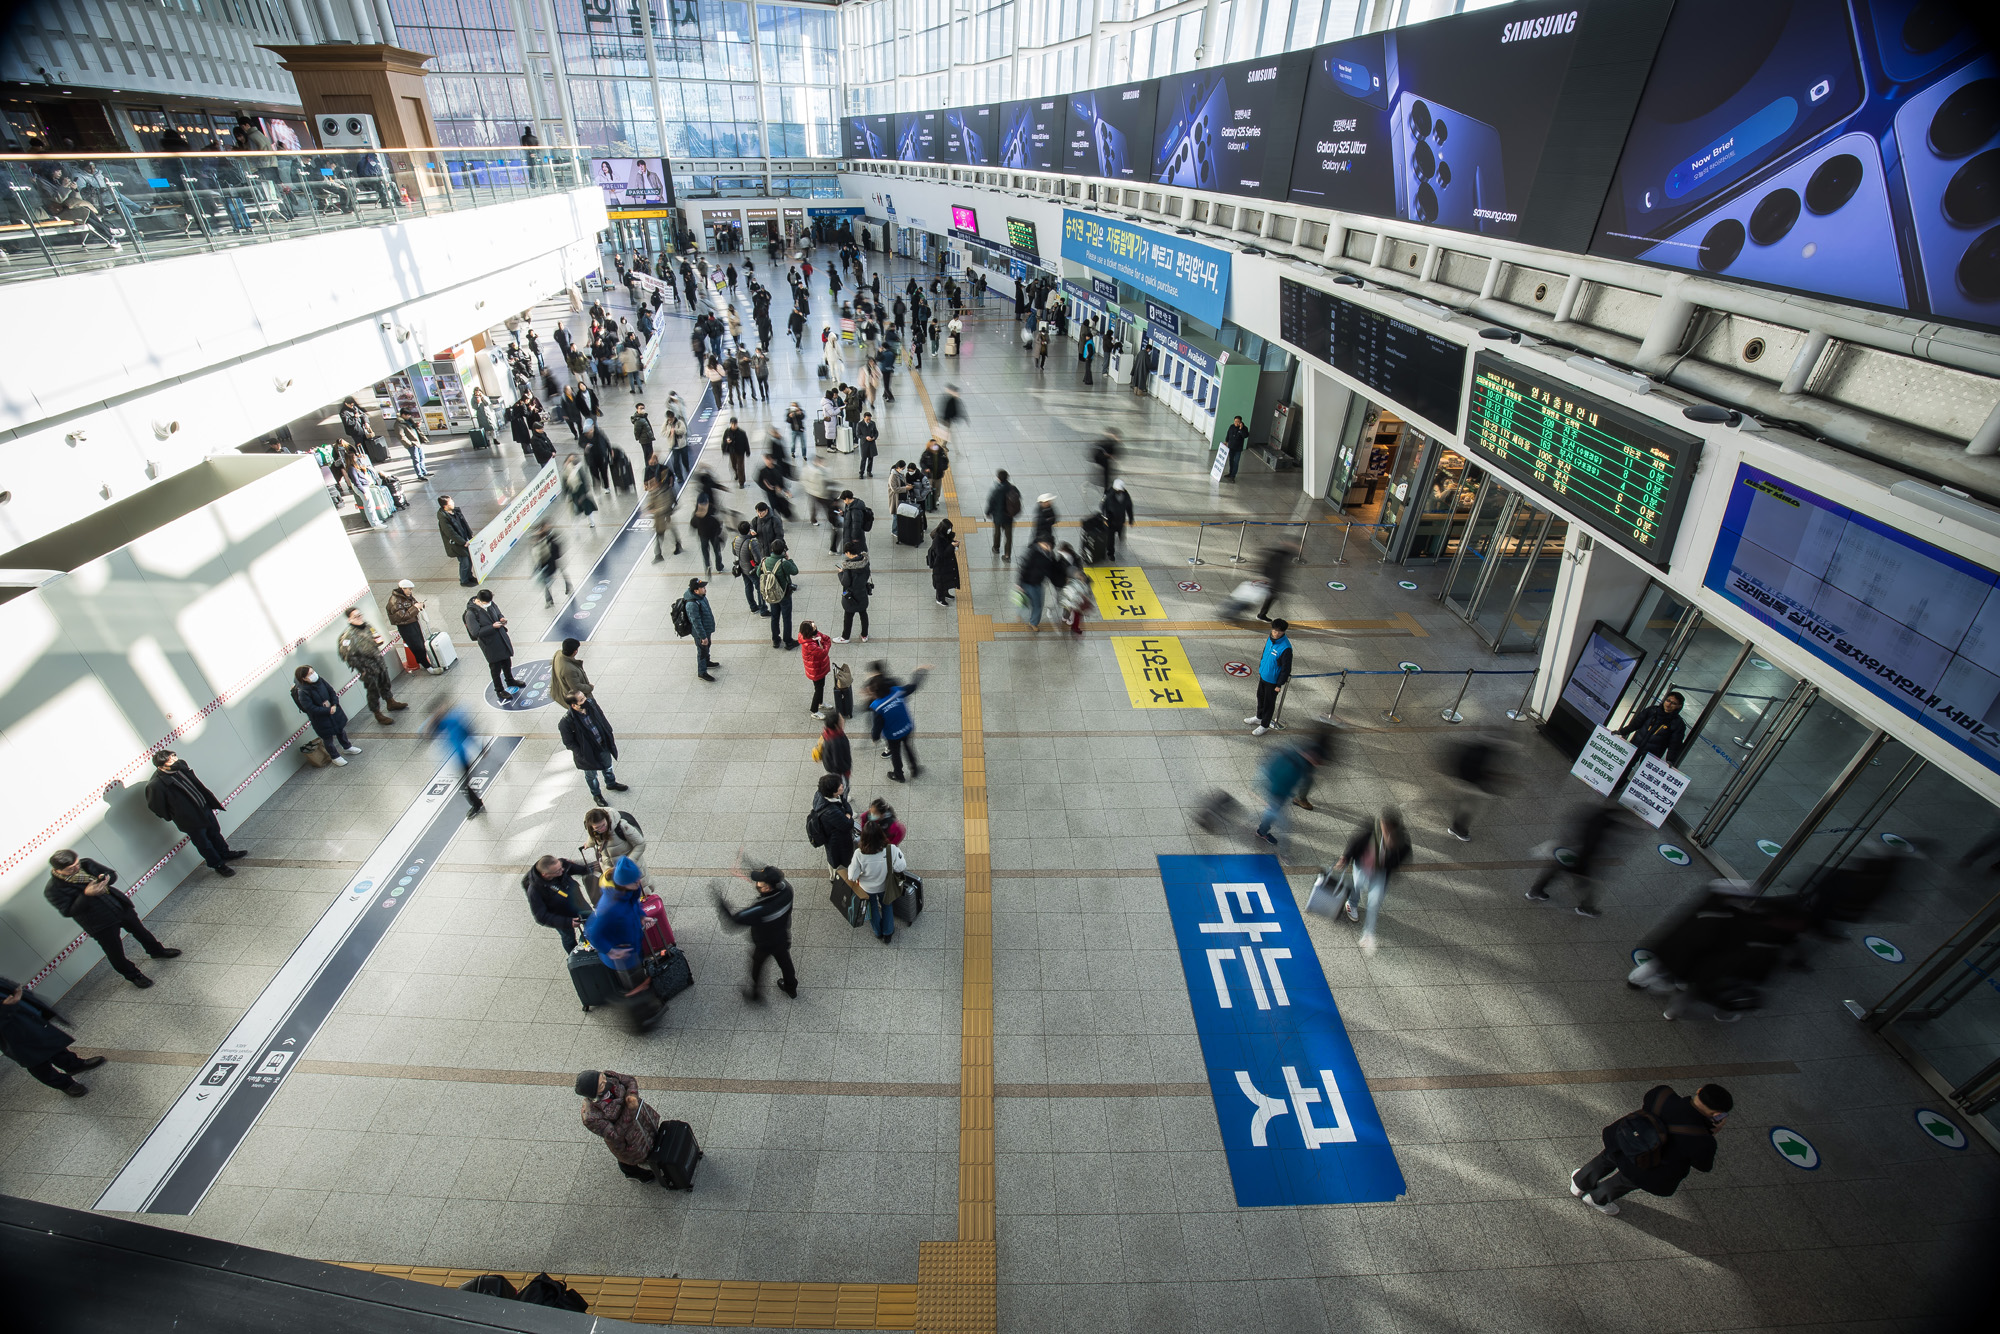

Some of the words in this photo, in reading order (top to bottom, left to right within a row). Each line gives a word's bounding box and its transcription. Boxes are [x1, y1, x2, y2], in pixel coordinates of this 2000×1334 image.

[1501, 10, 1578, 44] SAMSUNG
[1247, 67, 1277, 83] SAMSUNG
[1221, 127, 1237, 139] Galaxy
[1245, 125, 1261, 137] Series
[1316, 141, 1338, 156] Galaxy
[1338, 141, 1350, 154] S25
[1350, 141, 1367, 155] Ultra
[1691, 153, 1711, 171] Now
[1712, 137, 1735, 158] Brief
[1322, 160, 1340, 173] Galaxy
[1693, 166, 1709, 180] 오늘의
[1473, 207, 1517, 222] samsung.com
[1066, 216, 1084, 242] 승차권
[1086, 221, 1104, 248] 구입은
[1106, 226, 1150, 264] 자동발매기가
[1151, 244, 1173, 270] 빠르고
[1176, 251, 1219, 294] 편리합니다.
[1086, 250, 1097, 263] Please
[1106, 257, 1117, 270] ticket
[1117, 262, 1134, 276] machine
[1145, 274, 1157, 290] quick
[1157, 280, 1179, 297] purchase.
[1389, 319, 1418, 336] DEPARTURES
[1153, 328, 1167, 346] Foreign
[1167, 336, 1178, 350] Cards
[1178, 342, 1188, 355] NOT
[1187, 348, 1207, 369] Available
[1485, 399, 1500, 413] 10:12
[1502, 408, 1514, 419] KTX
[1542, 427, 1553, 439] 123
[1561, 437, 1575, 452] 부산
[1622, 470, 1629, 479] 8
[1487, 390, 1502, 402] 10:07
[1504, 398, 1515, 409] KTX
[1542, 417, 1555, 429] 209
[1624, 457, 1633, 468] 11
[1483, 419, 1498, 433] 10:23
[1500, 428, 1510, 439] ITX
[1511, 433, 1531, 451] 새마을
[1538, 449, 1553, 463] 1005
[1557, 459, 1572, 475] 부산
[1617, 492, 1623, 502] 6
[1484, 409, 1499, 423] 10:18
[1501, 418, 1512, 430] KTX
[1540, 438, 1551, 450] 163
[1559, 448, 1573, 463] 부산
[1620, 481, 1626, 491] 4
[1652, 458, 1666, 471] 지연
[1480, 438, 1495, 453] 10:32
[1497, 448, 1507, 459] KTX
[1533, 470, 1545, 482] 413
[1552, 479, 1567, 494] 목포
[1481, 428, 1497, 443] 10:28
[1498, 438, 1509, 449] KTX
[1535, 459, 1547, 471] 023
[1555, 470, 1569, 486] 부산
[1614, 504, 1621, 514] 5
[1745, 478, 1773, 494] BEST
[1105, 569, 1136, 601] 나오는
[1117, 605, 1146, 616] 곳
[1136, 640, 1171, 682] 나오는
[1733, 577, 1789, 615] 코레일톡
[1787, 611, 1835, 644] 실시간
[1833, 638, 1942, 709] 열차위치안내
[1937, 705, 2000, 748] 서비스
[1149, 688, 1184, 704] 곳
[1580, 758, 1594, 770] 마음
[1589, 741, 1626, 767] 임금인상으로
[1640, 769, 1660, 787] 노동권
[1645, 760, 1667, 779] 공공성
[1668, 772, 1684, 788] 강화!
[1632, 777, 1675, 807] 공공운수노조가
[1198, 882, 1293, 1011] 타는
[220, 1054, 243, 1062] 공항철도
[246, 1075, 262, 1083] 지하철
[272, 1076, 280, 1084] 곳
[1234, 1065, 1358, 1150] 곳
